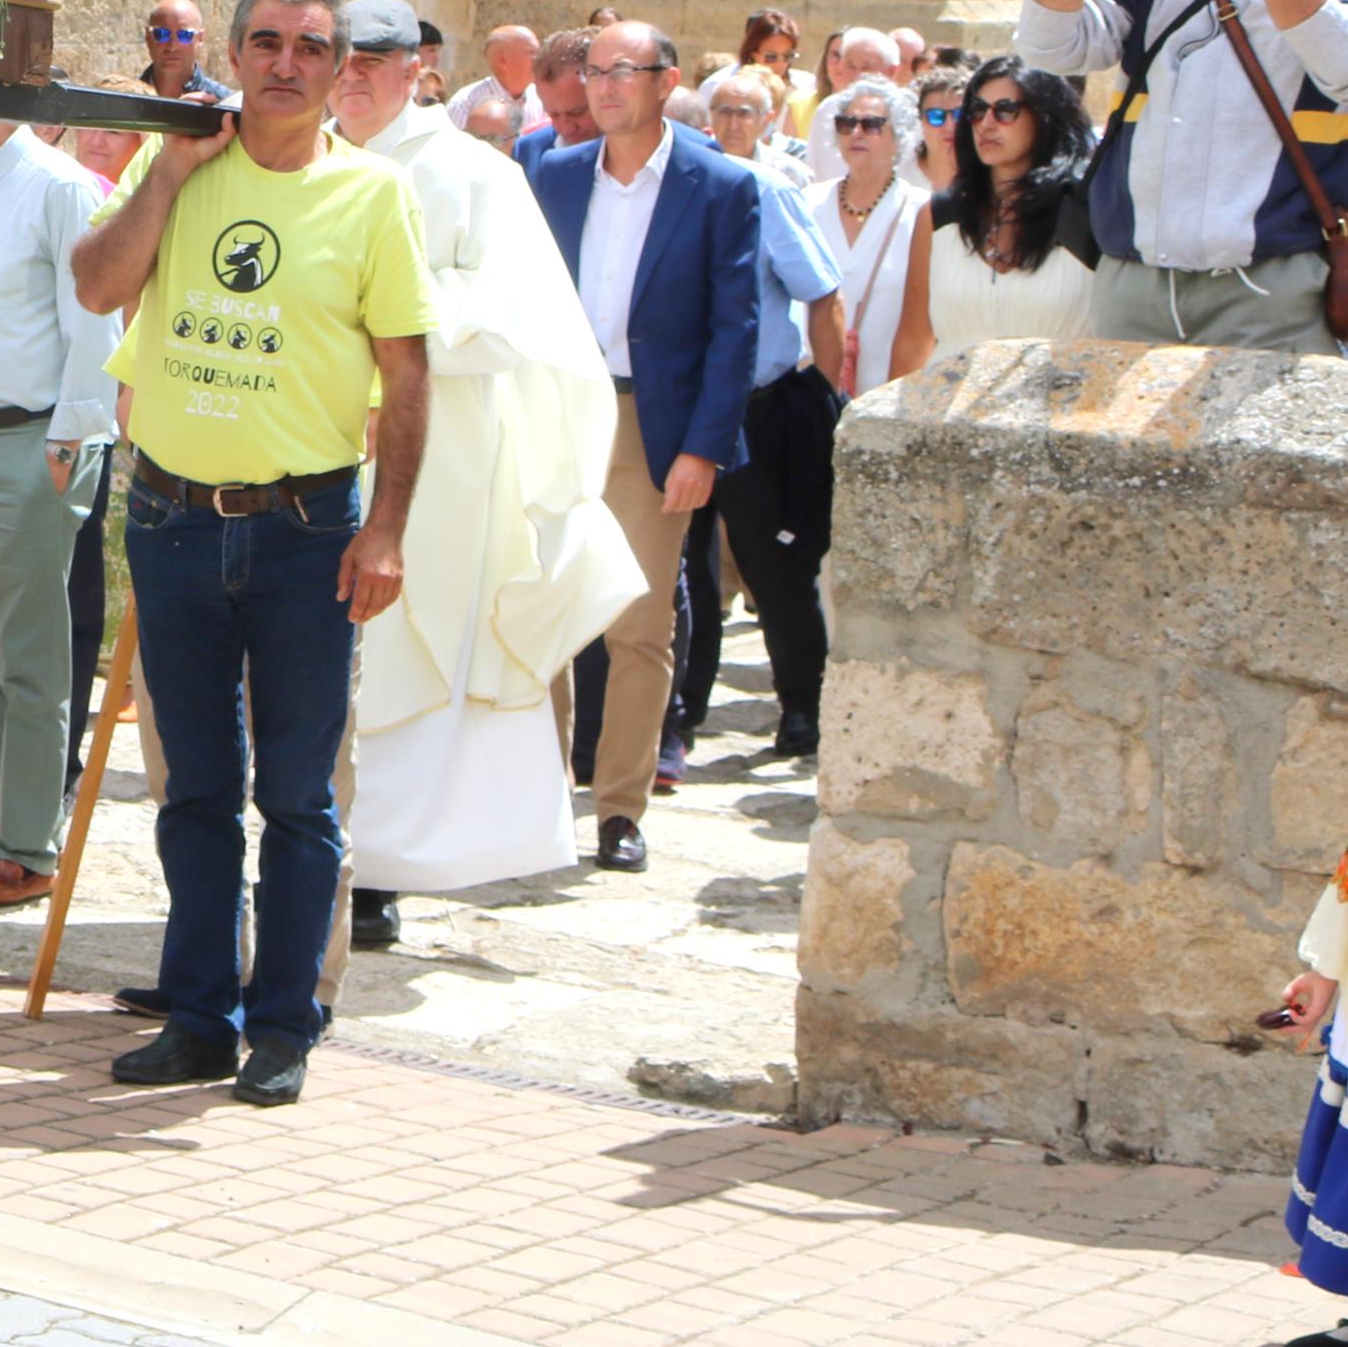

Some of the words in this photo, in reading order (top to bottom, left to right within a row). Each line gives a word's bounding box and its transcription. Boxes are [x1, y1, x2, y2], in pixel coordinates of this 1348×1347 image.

[185, 290, 206, 310] SE
[210, 294, 281, 323] BUSCAN
[163, 355, 278, 393] TORQUEMADA
[185, 389, 240, 419] 2022
